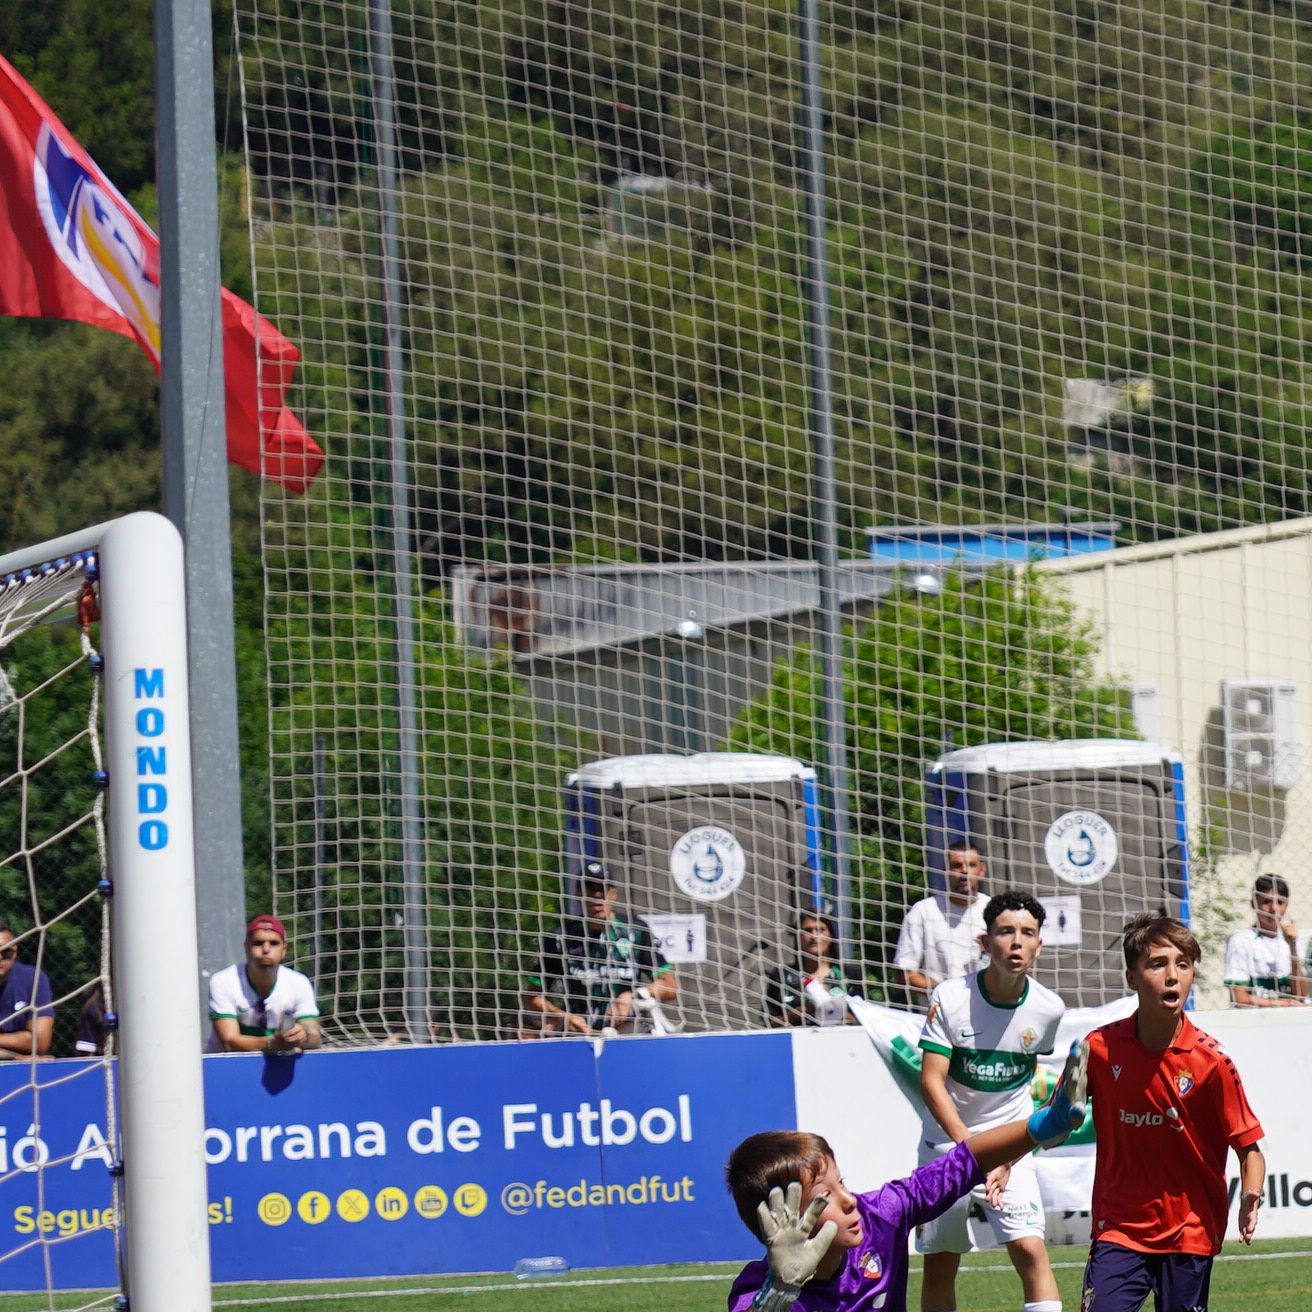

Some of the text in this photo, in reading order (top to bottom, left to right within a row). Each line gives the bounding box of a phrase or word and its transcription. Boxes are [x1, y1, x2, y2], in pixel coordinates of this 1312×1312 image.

[134, 668, 168, 850] MONDO
[70, 1120, 386, 1171] Aorrana
[407, 1107, 481, 1154] de
[502, 1095, 692, 1149] Futbol
[1120, 1108, 1164, 1127] Jaylo
[501, 1175, 695, 1216] @fedandfut
